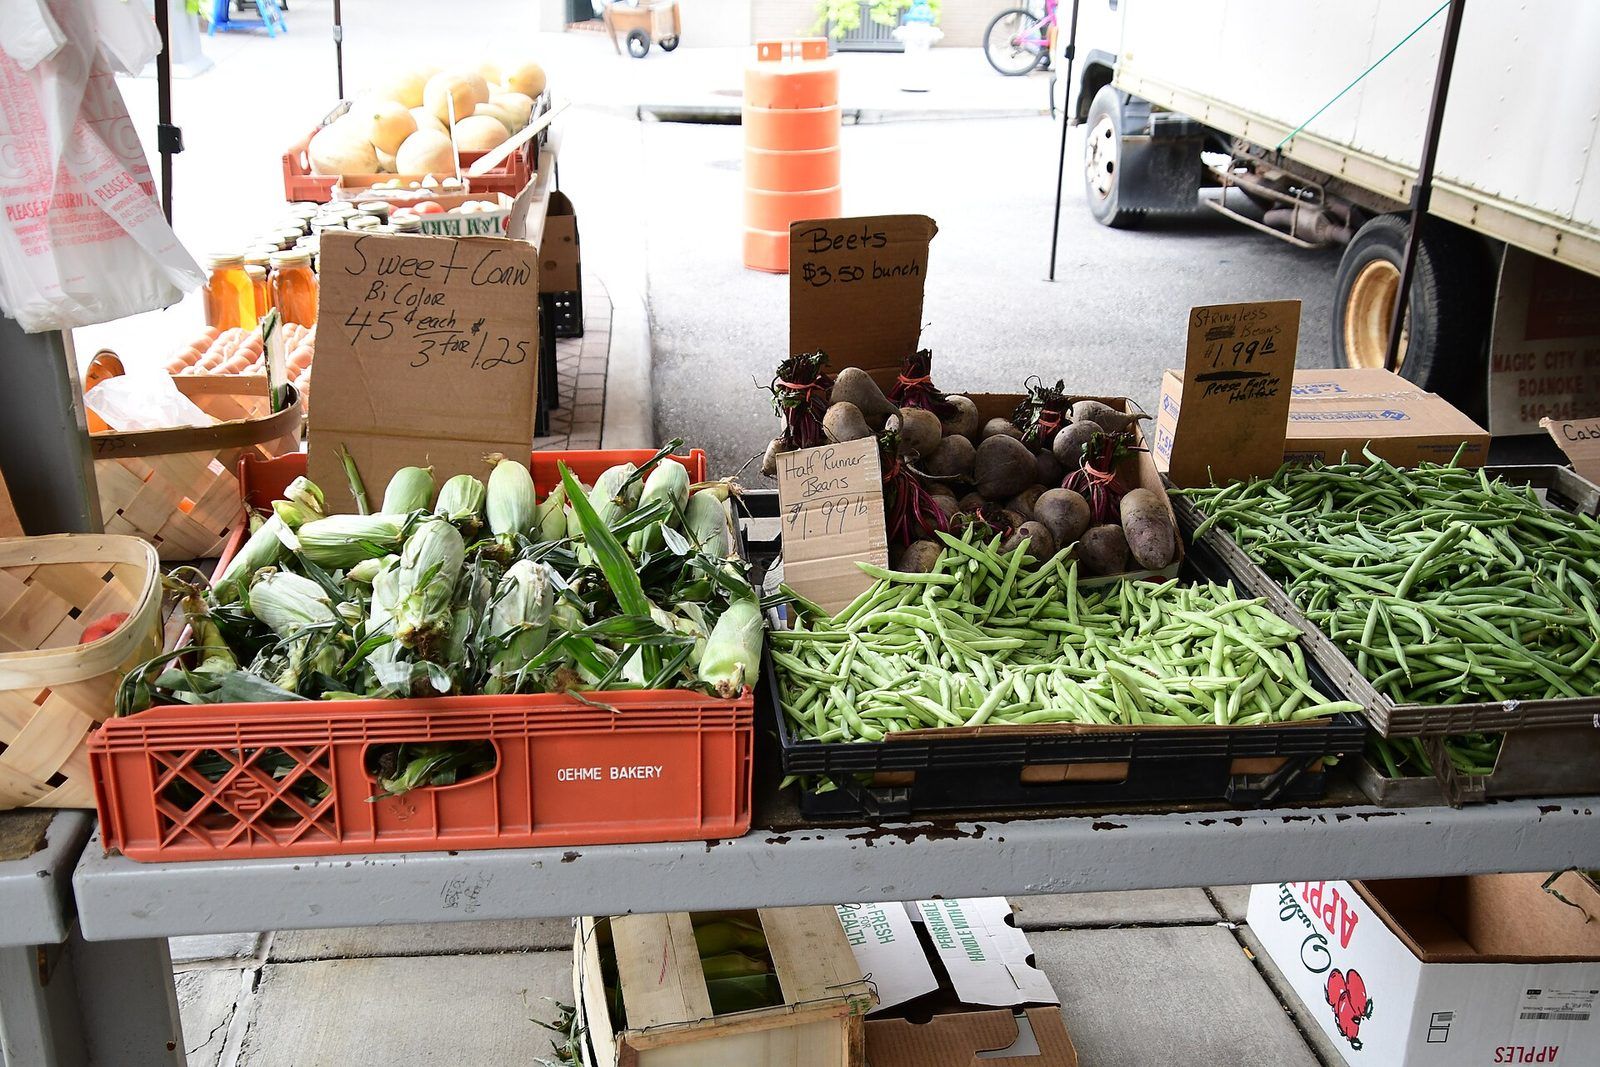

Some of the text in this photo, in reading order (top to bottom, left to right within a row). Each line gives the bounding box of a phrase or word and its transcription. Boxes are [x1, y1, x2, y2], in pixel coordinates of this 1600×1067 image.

[800, 225, 888, 253] Beets
[345, 235, 468, 284] Sweet
[803, 259, 919, 287] $3.50 bunch
[364, 280, 386, 302] Bi
[416, 309, 456, 330] each
[410, 340, 436, 367] 3
[1493, 352, 1537, 373] MAGIC
[1544, 350, 1577, 370] CITY
[1519, 375, 1584, 397] ROANOKE
[785, 447, 866, 480] Half Runner
[800, 476, 849, 498] Beans
[557, 765, 663, 782] OEHME BAKERY
[836, 904, 868, 947] HEALTH
[858, 915, 872, 929] FOR
[868, 909, 896, 945] FRESH
[921, 901, 957, 950] PERISHABLE
[946, 908, 970, 930] WITH
[956, 930, 986, 962] HANDLE
[1493, 1045, 1559, 1063] APPLES
